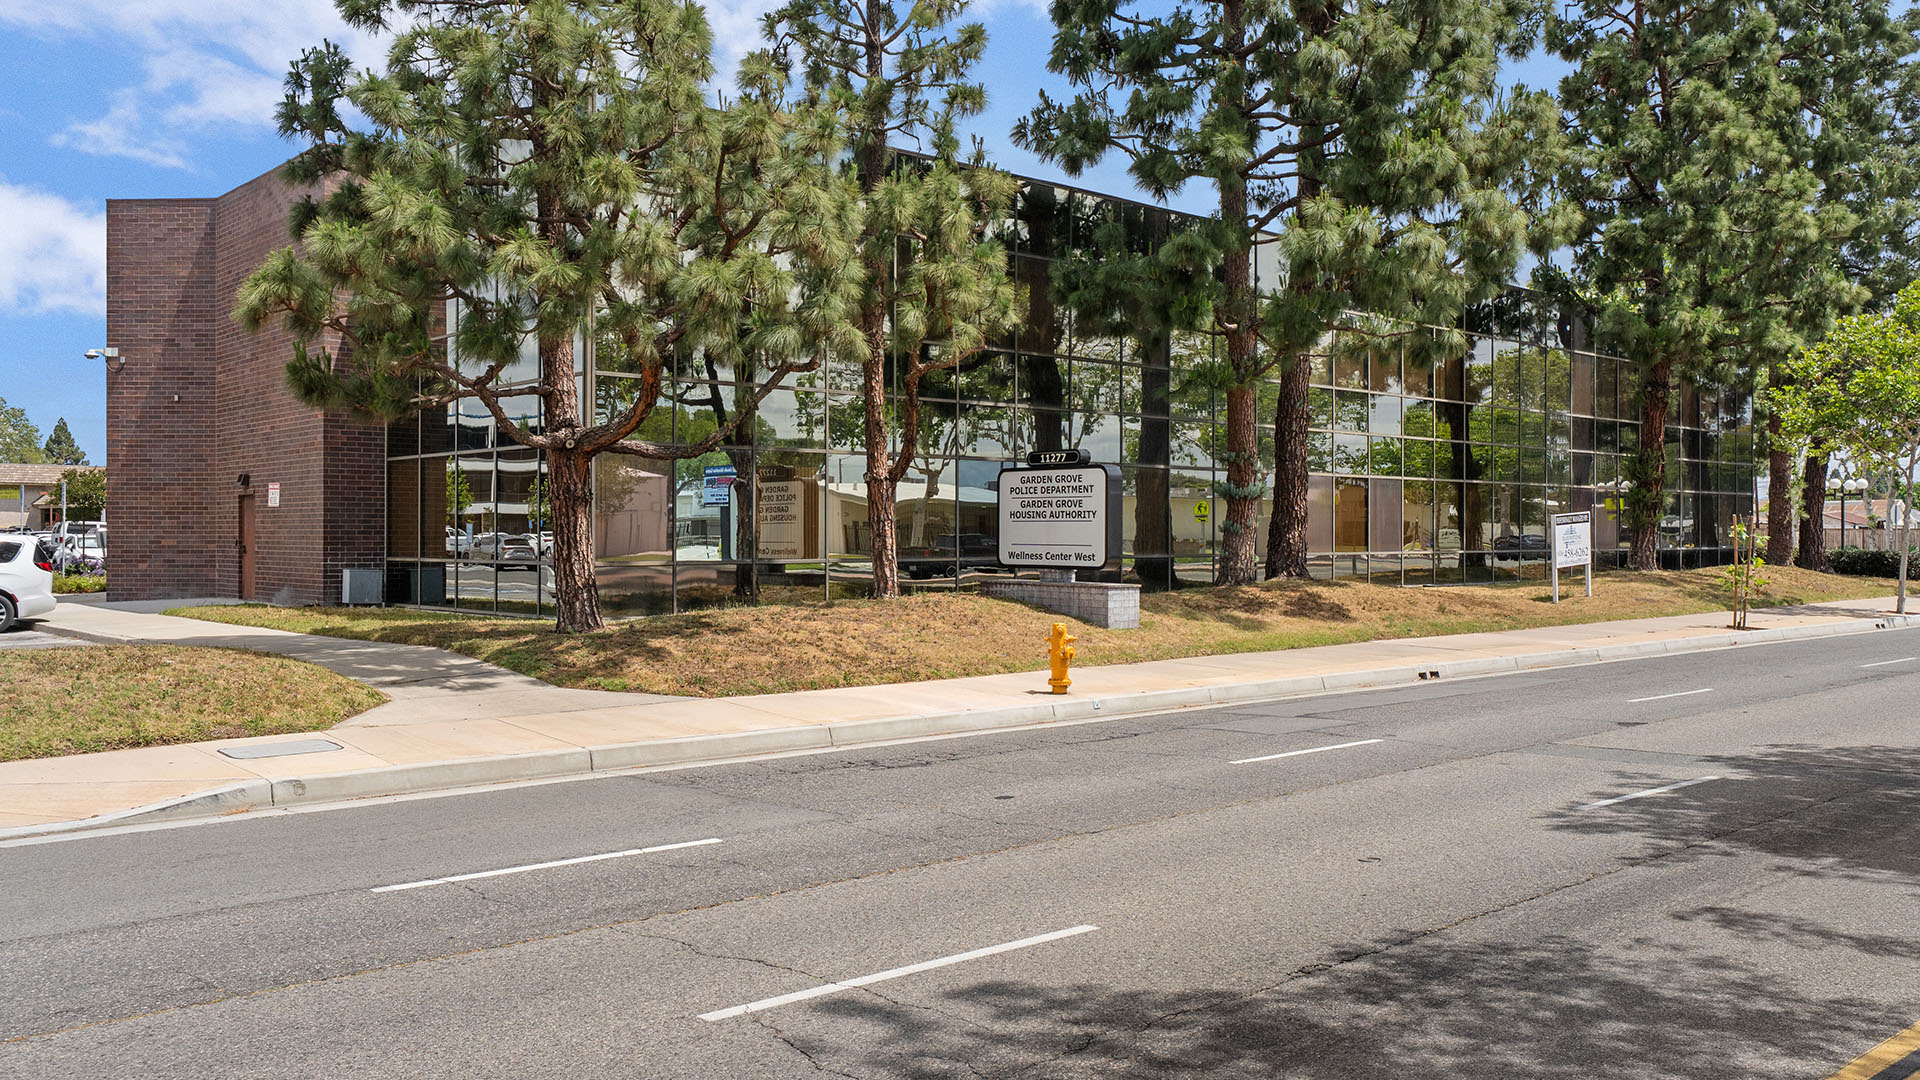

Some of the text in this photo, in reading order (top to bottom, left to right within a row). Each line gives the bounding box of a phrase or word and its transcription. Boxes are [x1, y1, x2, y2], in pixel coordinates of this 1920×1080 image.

[1040, 453, 1067, 463] 11277
[1020, 474, 1083, 485] GARDEN GROVE
[1010, 484, 1094, 495] POLICE DEPARTMENT
[1020, 499, 1083, 509] GARDEN GROVE
[1009, 510, 1097, 519] HOUSING AUTHORITY
[1008, 551, 1096, 562] Wellness Center West
